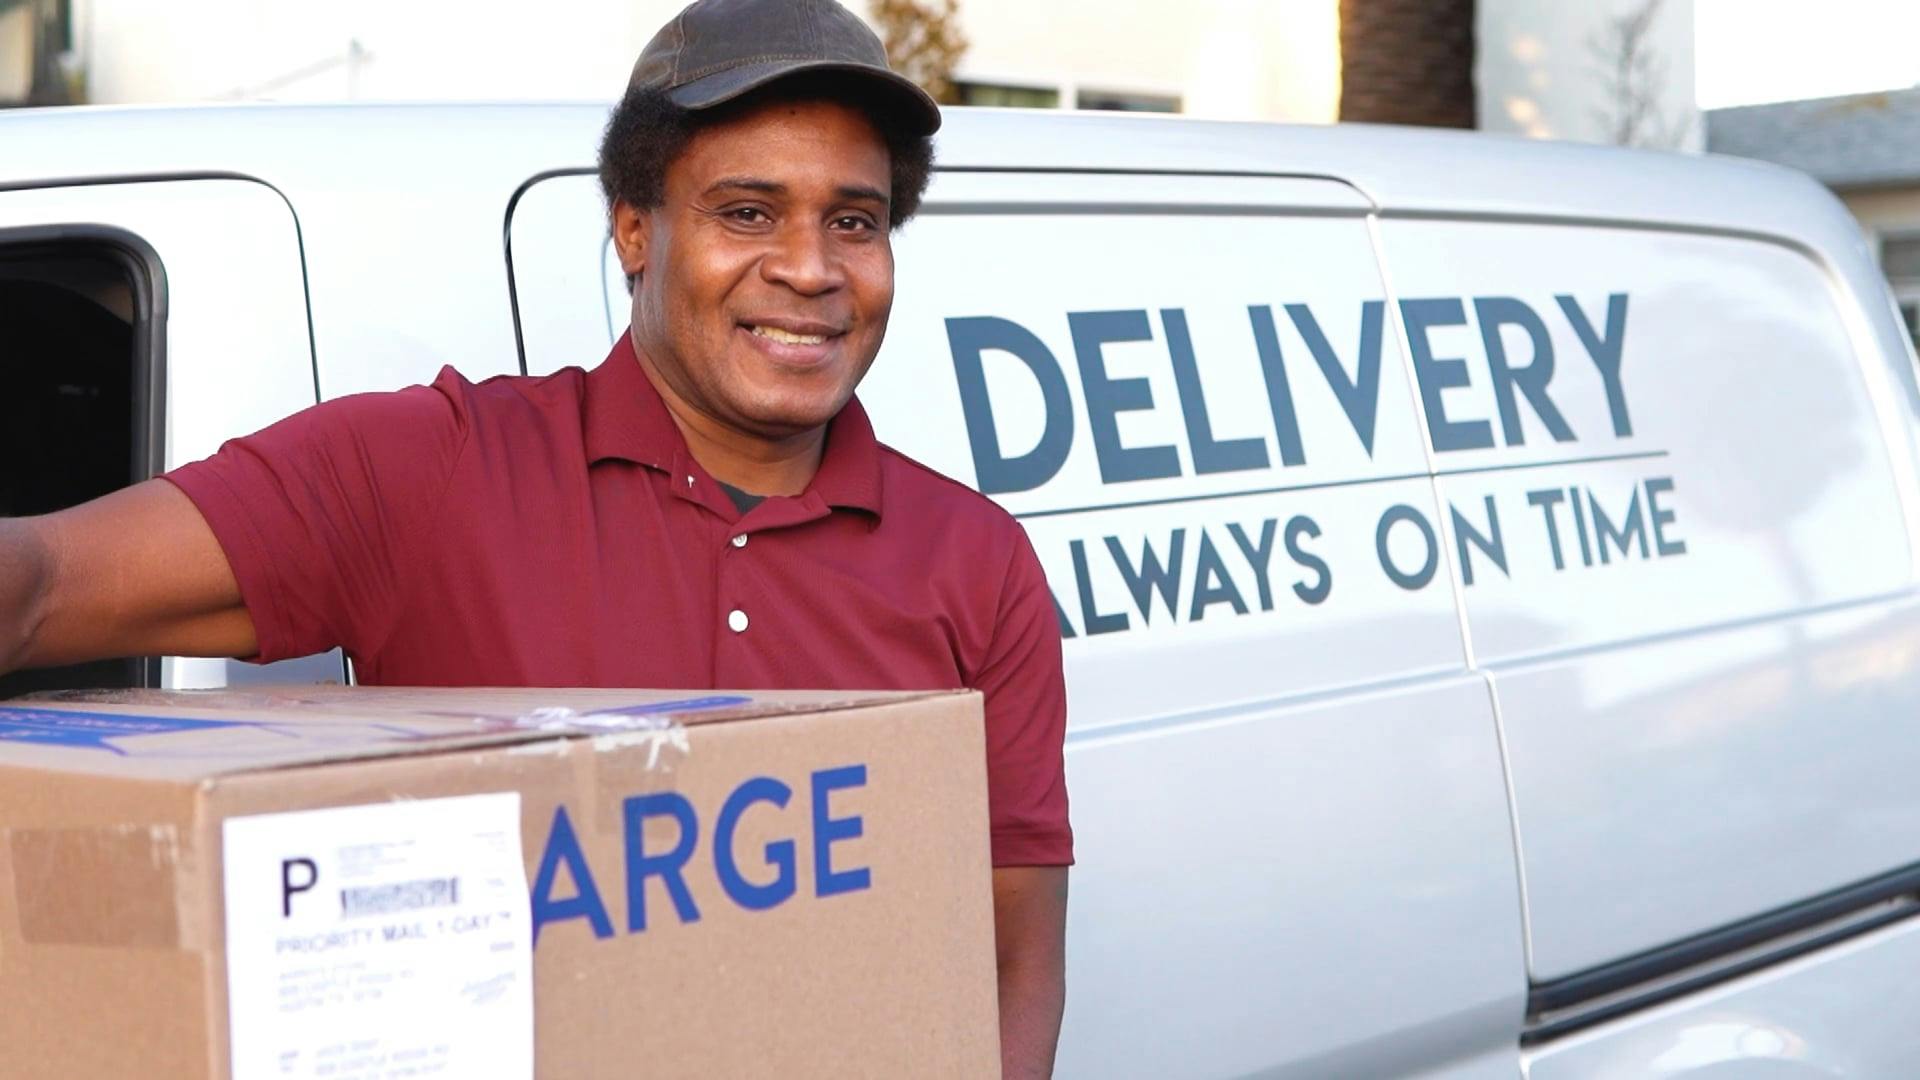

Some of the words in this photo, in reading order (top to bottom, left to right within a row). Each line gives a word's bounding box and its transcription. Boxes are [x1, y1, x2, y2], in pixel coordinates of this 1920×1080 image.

[944, 293, 1633, 494] DELIVERY
[1048, 514, 1332, 638] LWAYS
[1376, 495, 1510, 591] ON
[1526, 477, 1687, 571] TIME
[282, 857, 318, 918] P
[382, 921, 428, 943] MAIL
